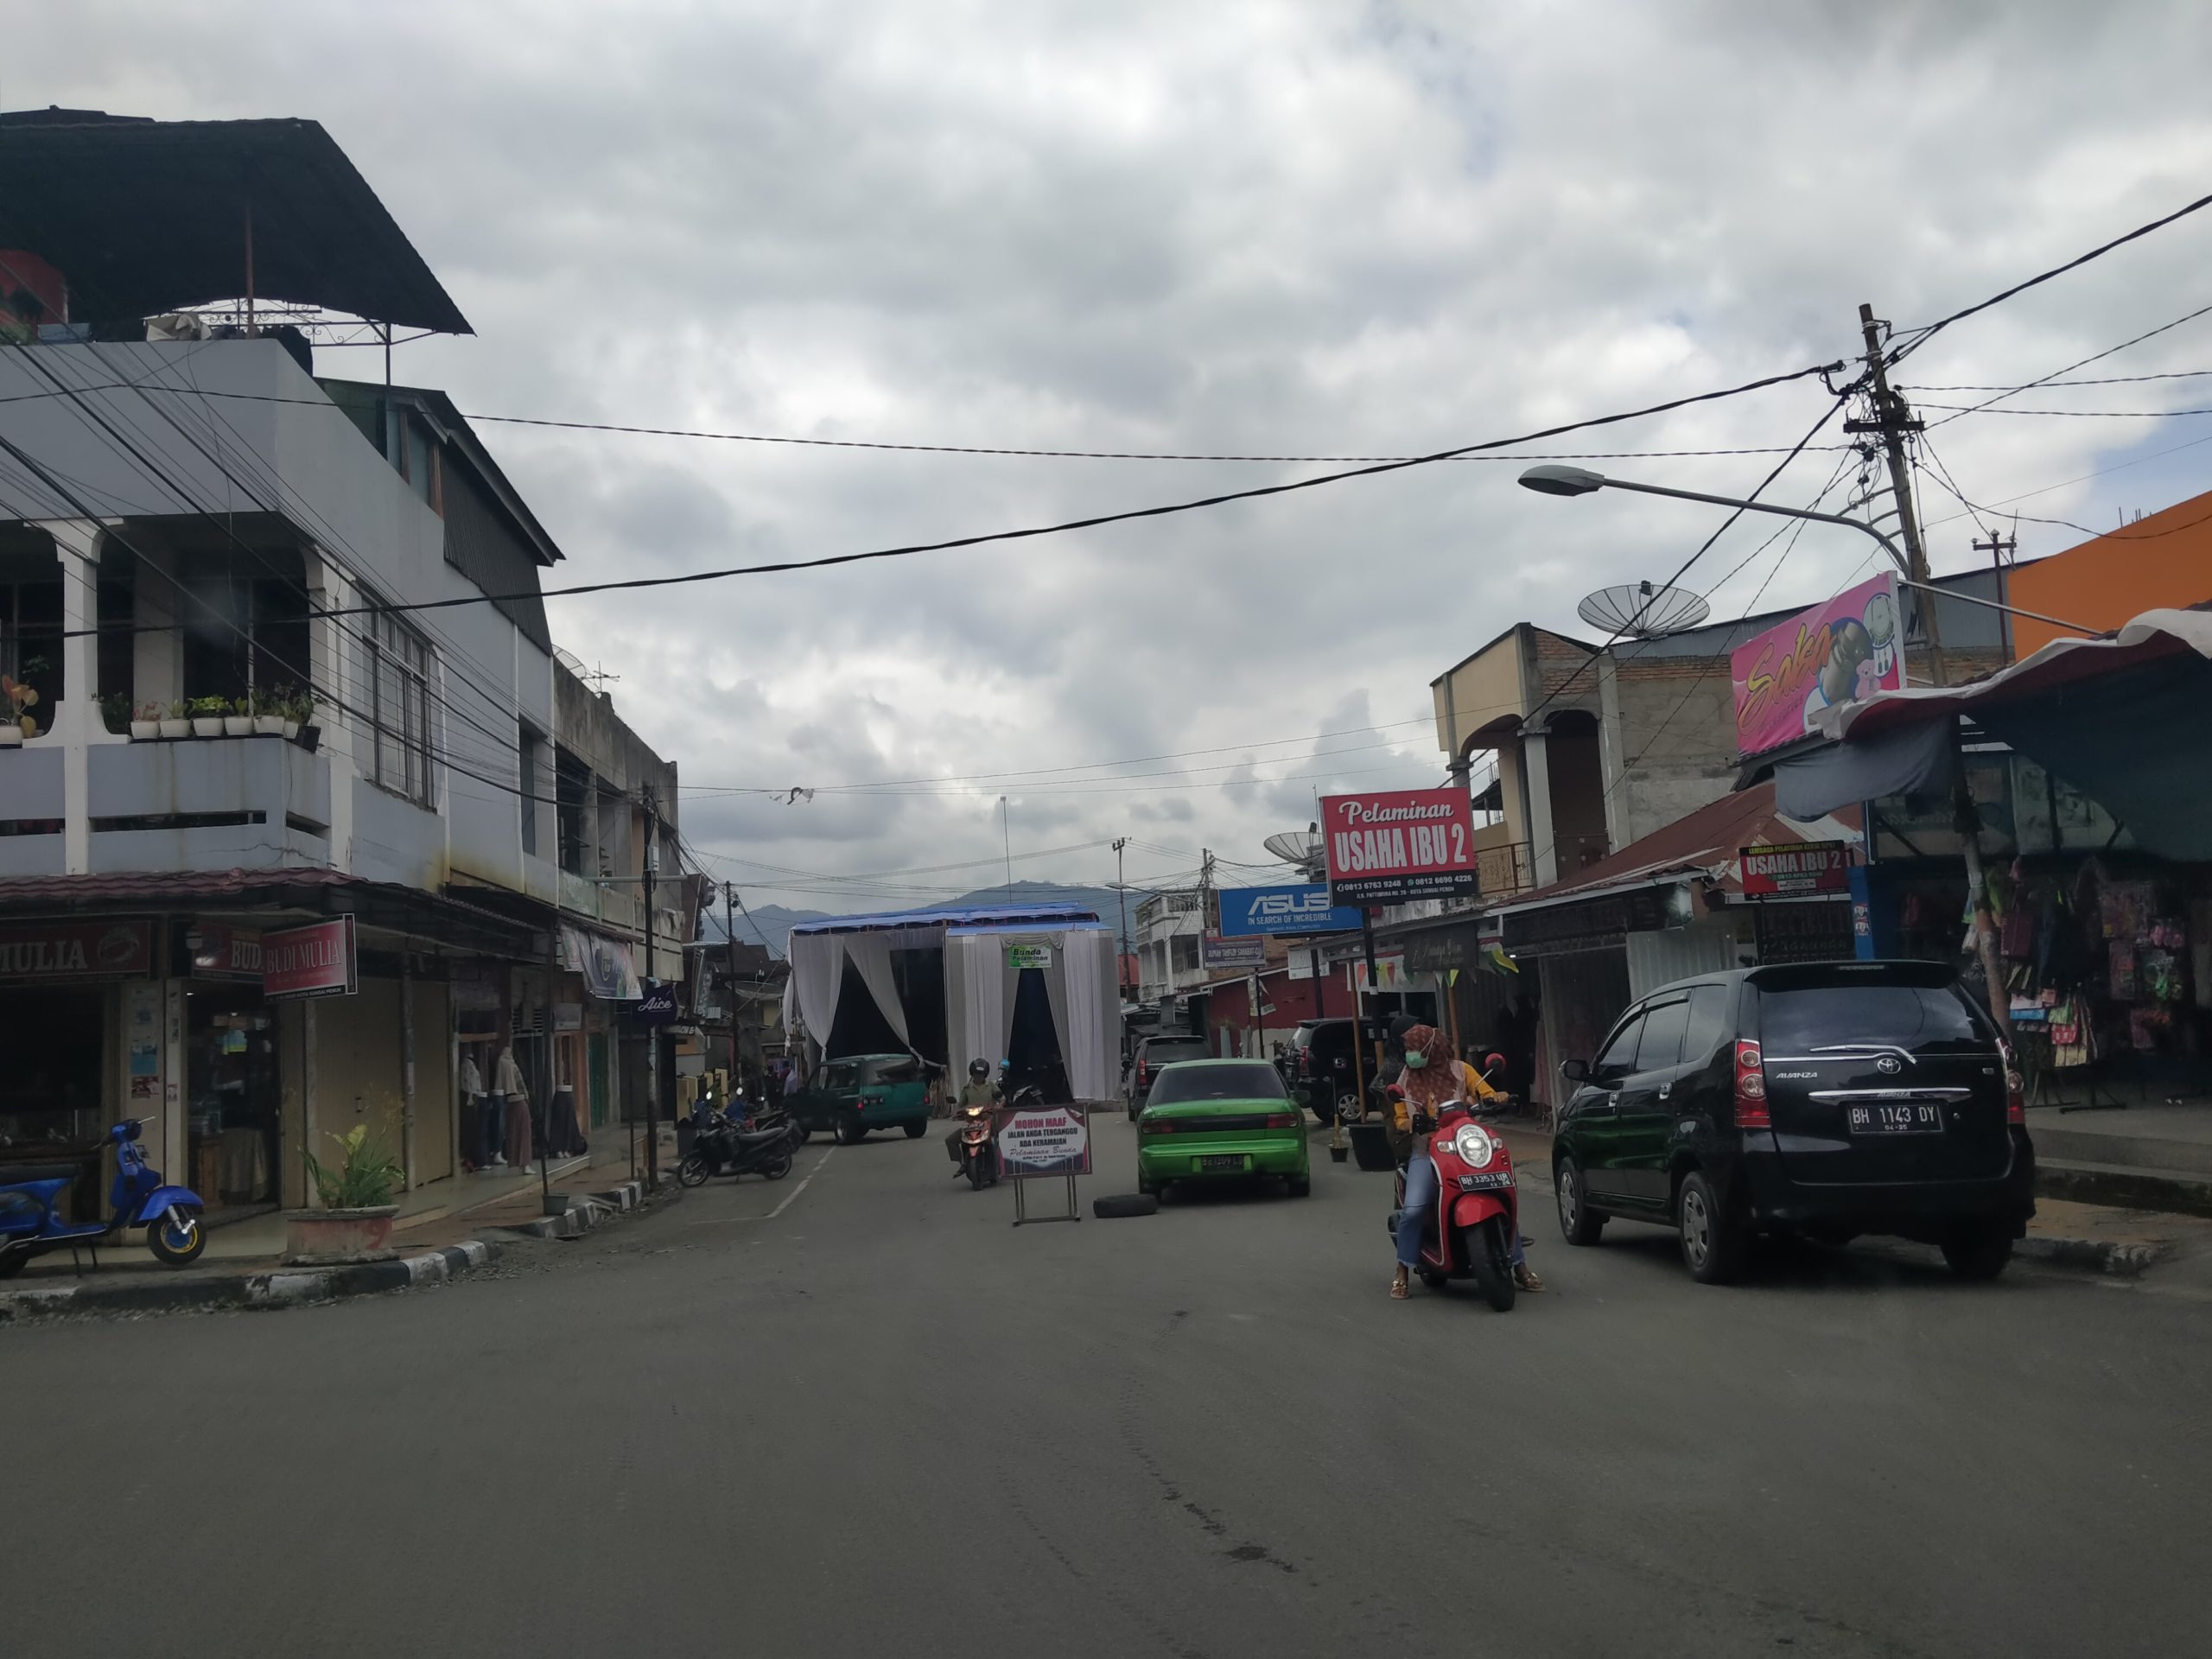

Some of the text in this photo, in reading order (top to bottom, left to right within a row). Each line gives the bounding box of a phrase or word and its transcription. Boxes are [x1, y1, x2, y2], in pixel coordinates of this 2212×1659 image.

[1338, 800, 1454, 825] Pelaminan
[1335, 823, 1466, 872] USAHA IBU 2
[1746, 851, 1841, 875] USAHA IBU 2
[1344, 882, 1363, 891] 0813
[1248, 892, 1330, 915] ASUS
[1257, 916, 1281, 925] SEARCH
[1294, 912, 1332, 923] INCREDIBLE
[231, 940, 263, 969] BUD
[268, 940, 341, 974] BUDI MULIA
[638, 997, 672, 1012] Aice
[1853, 1106, 1934, 1123] BH 1143 DY
[1015, 1117, 1066, 1129] MOHON MAAF
[1026, 1129, 1041, 1138] ANDA
[1043, 1127, 1077, 1137] TERGANGGU
[1033, 1138, 1066, 1147] KERAMAIAN
[1009, 1146, 1077, 1157] Pelaminan Bunda
